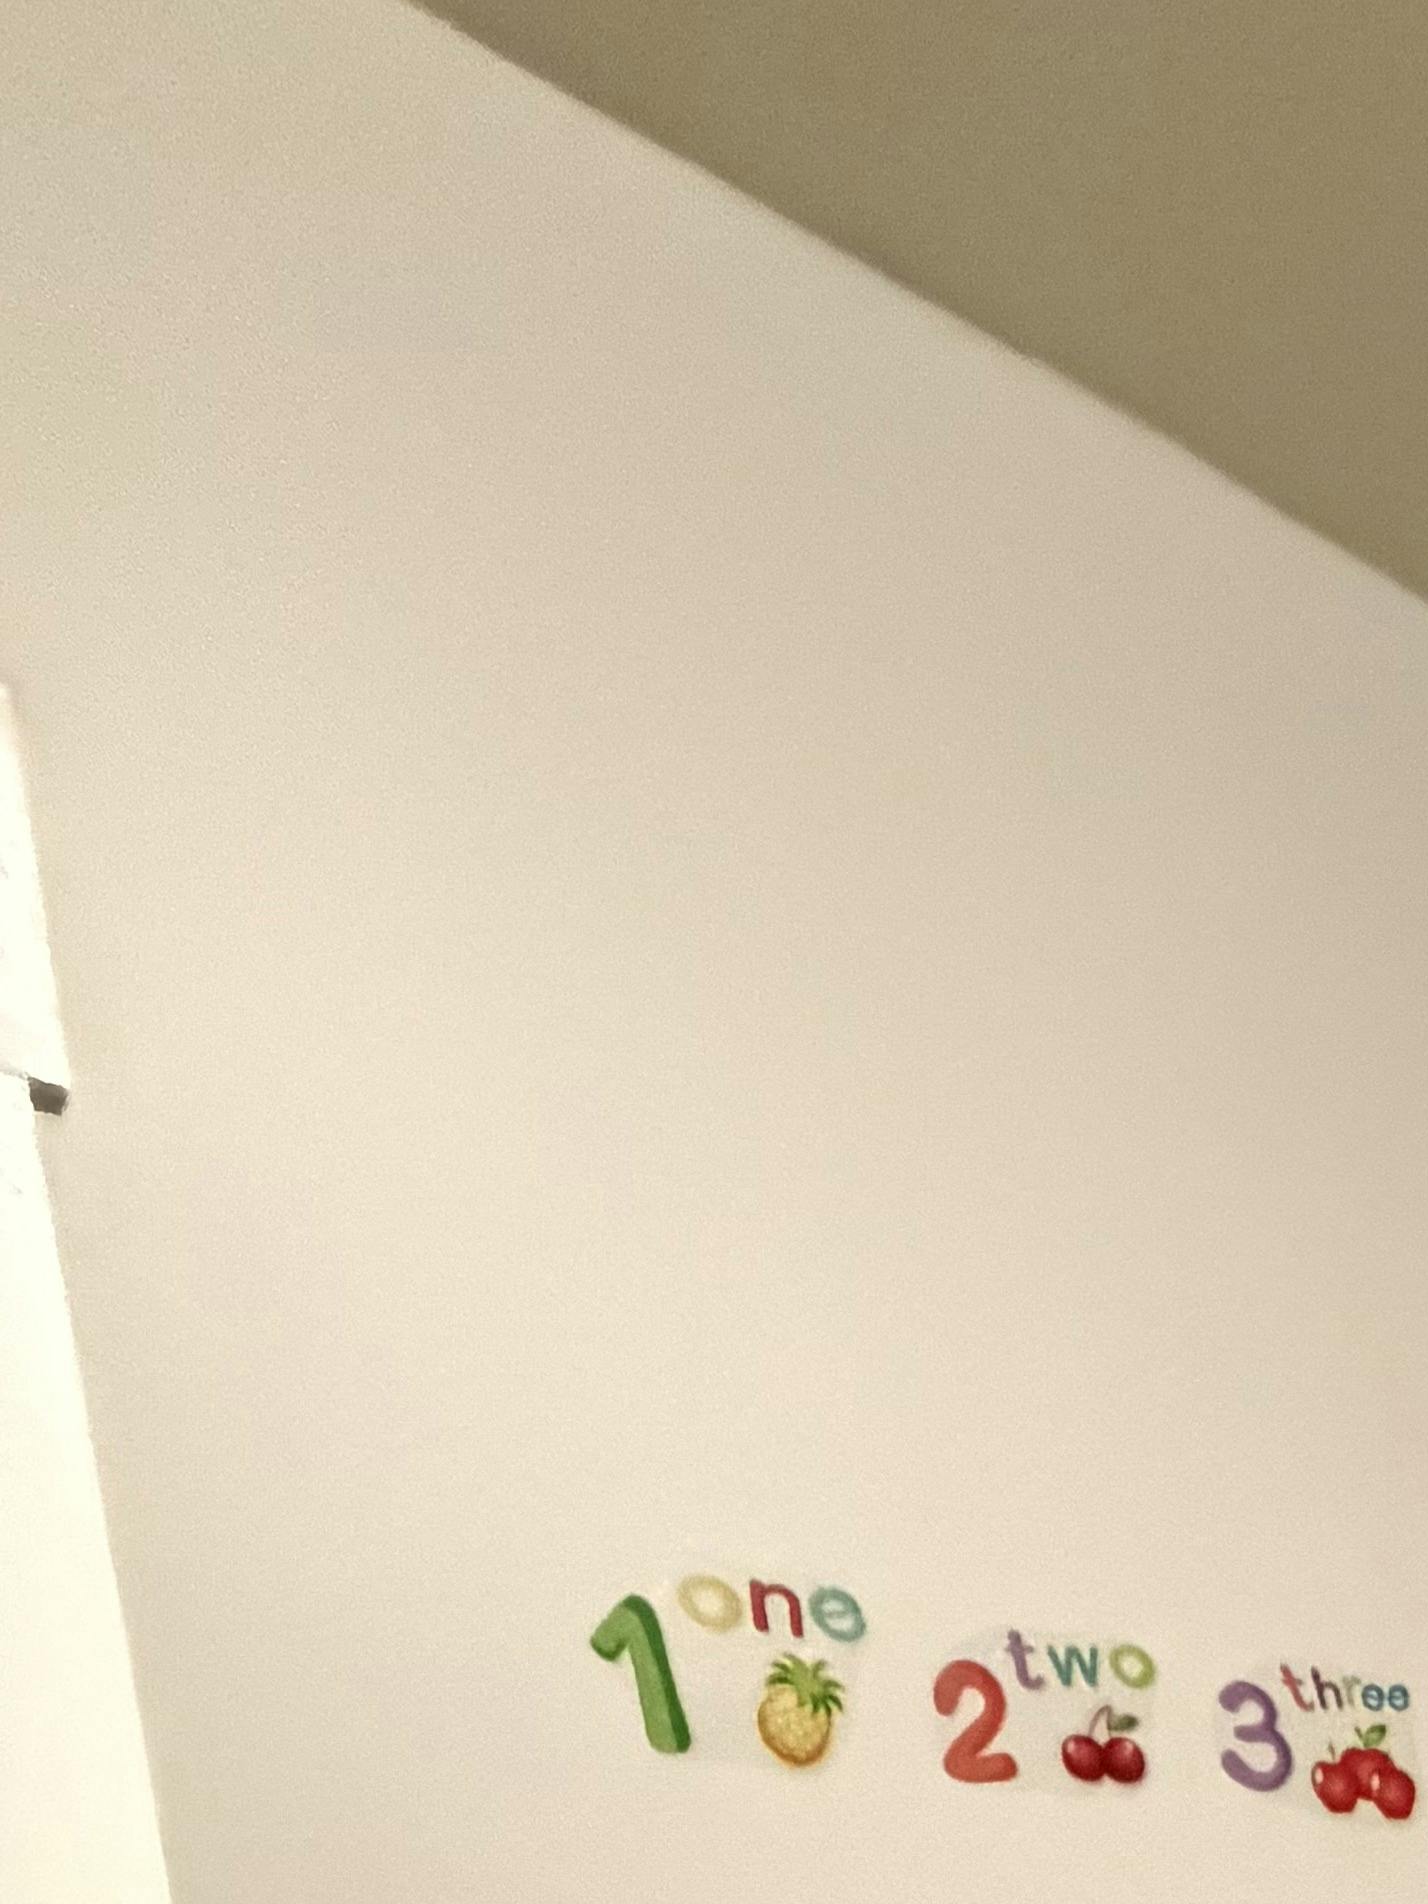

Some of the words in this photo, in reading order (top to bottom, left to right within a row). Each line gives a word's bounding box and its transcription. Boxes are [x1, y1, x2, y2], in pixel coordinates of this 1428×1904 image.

[590, 1594, 691, 1754] 1
[677, 1575, 867, 1642] one
[933, 1660, 1018, 1783] 2
[1006, 1629, 1157, 1690] two
[1218, 1680, 1293, 1792] 3
[1280, 1663, 1411, 1712] three
